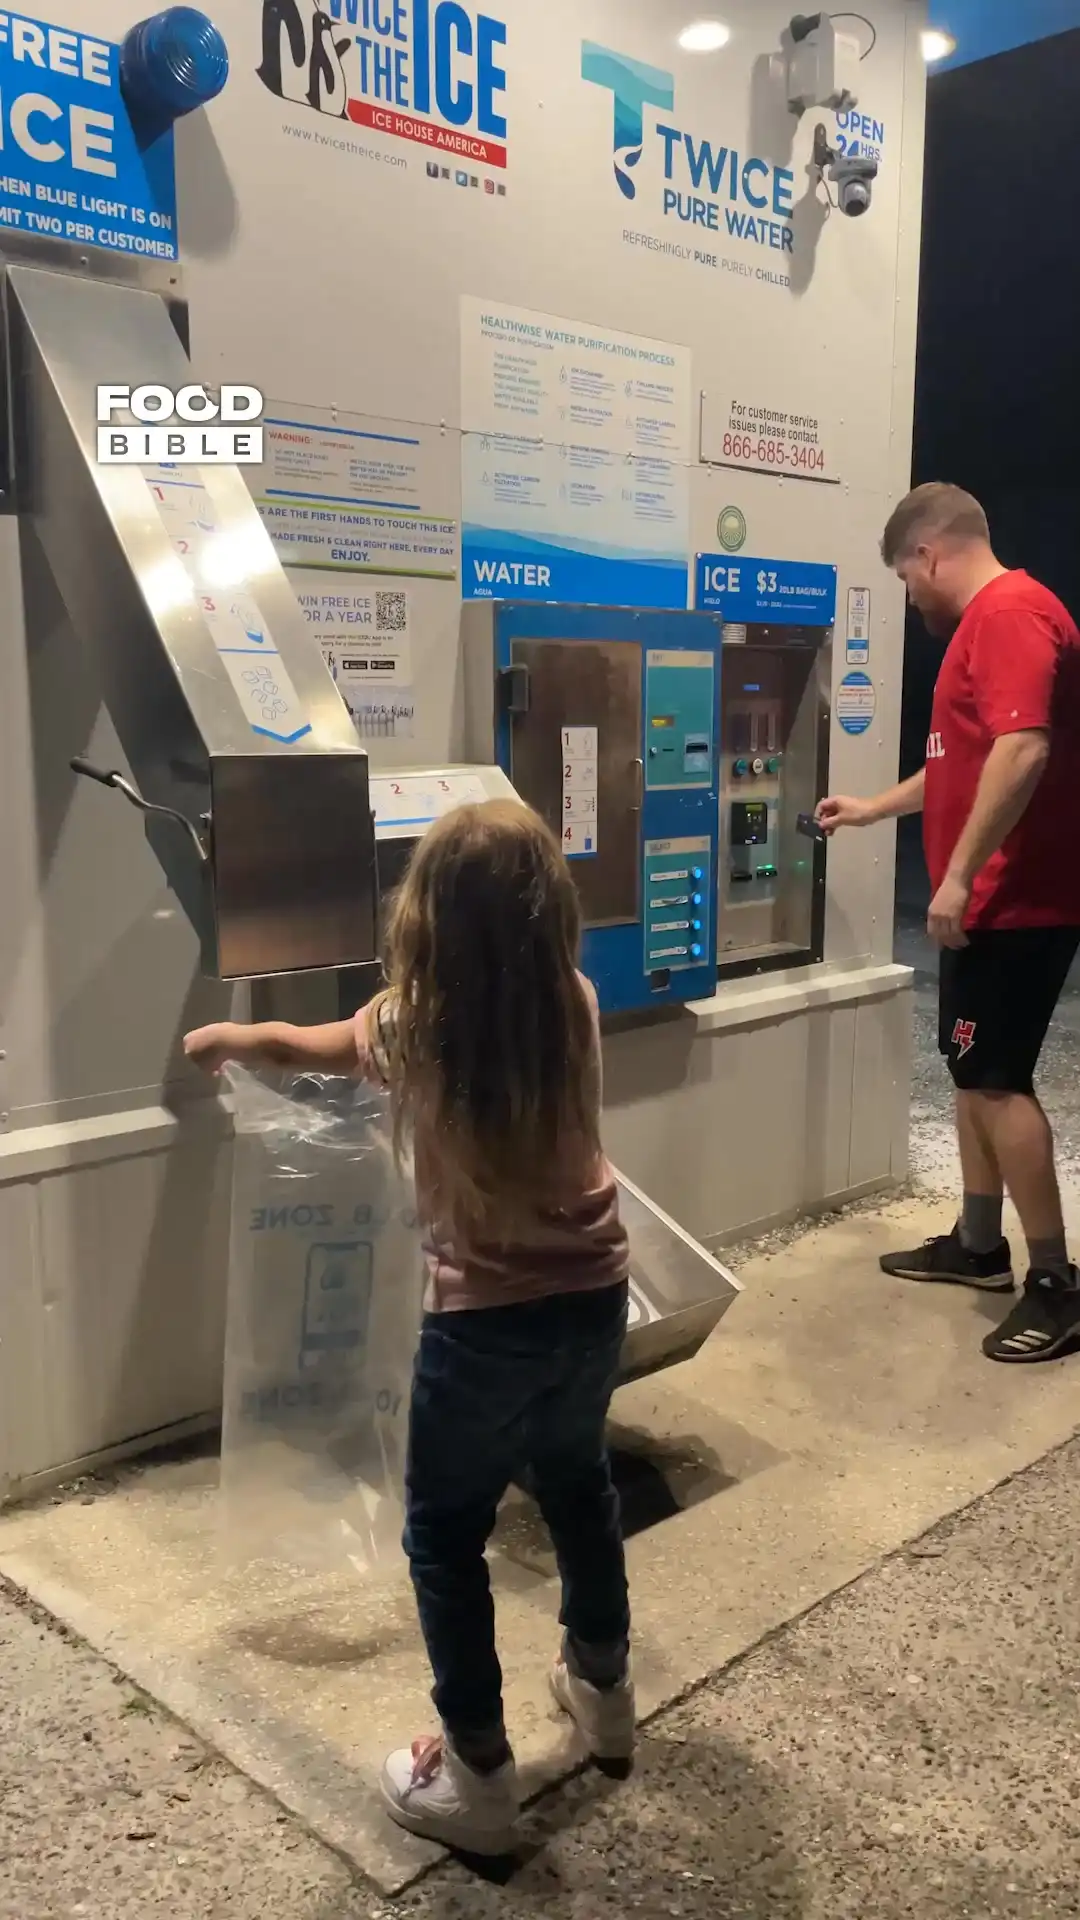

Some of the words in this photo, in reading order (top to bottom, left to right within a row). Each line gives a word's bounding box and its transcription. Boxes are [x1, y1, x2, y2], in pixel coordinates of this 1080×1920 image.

[329, 0, 408, 43] ICE
[355, 36, 409, 109] THE
[413, 0, 507, 139] ICE
[0, 85, 117, 179] CE
[372, 110, 392, 130] ICE
[396, 116, 434, 143] HOUSE
[436, 131, 488, 160] AMERICA
[836, 110, 884, 145] OPEN
[281, 123, 408, 170] www.twicetheice.com
[836, 134, 860, 157] 24
[656, 123, 794, 220] TWICE
[0, 176, 31, 198] HEN
[35, 183, 78, 209] BLUE
[82, 195, 128, 220] LIGHT
[131, 207, 146, 225] IS
[149, 211, 172, 231] ON
[0, 206, 22, 225] MIT
[25, 211, 63, 234] TWO
[65, 220, 95, 242] PER
[98, 228, 175, 260] CUSTOMER
[664, 187, 719, 231] PURE
[724, 207, 794, 254] WATER
[622, 229, 693, 261] REFRESHINGLY
[693, 251, 718, 268] PURE
[720, 257, 755, 279] PURELY
[480, 314, 542, 338] HEALTHWISE
[544, 328, 576, 346] WATER
[577, 336, 637, 360] PURIFICATION
[638, 350, 676, 368] PROCESS
[728, 415, 757, 433] issues
[759, 421, 786, 439] please
[731, 400, 747, 416] For
[748, 406, 788, 424] customer
[789, 413, 819, 430] service
[722, 432, 825, 473] 866-685-3404
[267, 507, 288, 517] ARE
[290, 509, 309, 519] THE
[311, 511, 337, 522] FIRST
[339, 515, 372, 526] HANDS
[374, 518, 385, 527] TO
[387, 519, 417, 530] TOUCH
[420, 522, 438, 532] THIS
[297, 534, 325, 545] FRESH
[334, 537, 362, 548] CLEAN
[363, 540, 389, 551] RIGHT
[413, 545, 438, 555] EVERY
[331, 549, 371, 562] ENJOY.
[473, 559, 551, 588] WATER
[704, 565, 741, 593] ICE
[756, 569, 778, 596] $3
[201, 596, 216, 611] 3
[321, 596, 350, 608] FREE
[353, 597, 371, 609] ICE
[473, 587, 493, 596] AGUA
[303, 609, 321, 622] OR
[324, 610, 335, 623] A
[338, 611, 373, 624] YEAR
[564, 732, 570, 746] 1
[564, 764, 573, 778] 2
[390, 783, 403, 795] 2
[438, 780, 450, 792] 3
[564, 796, 573, 809] 3
[564, 827, 573, 841] 4
